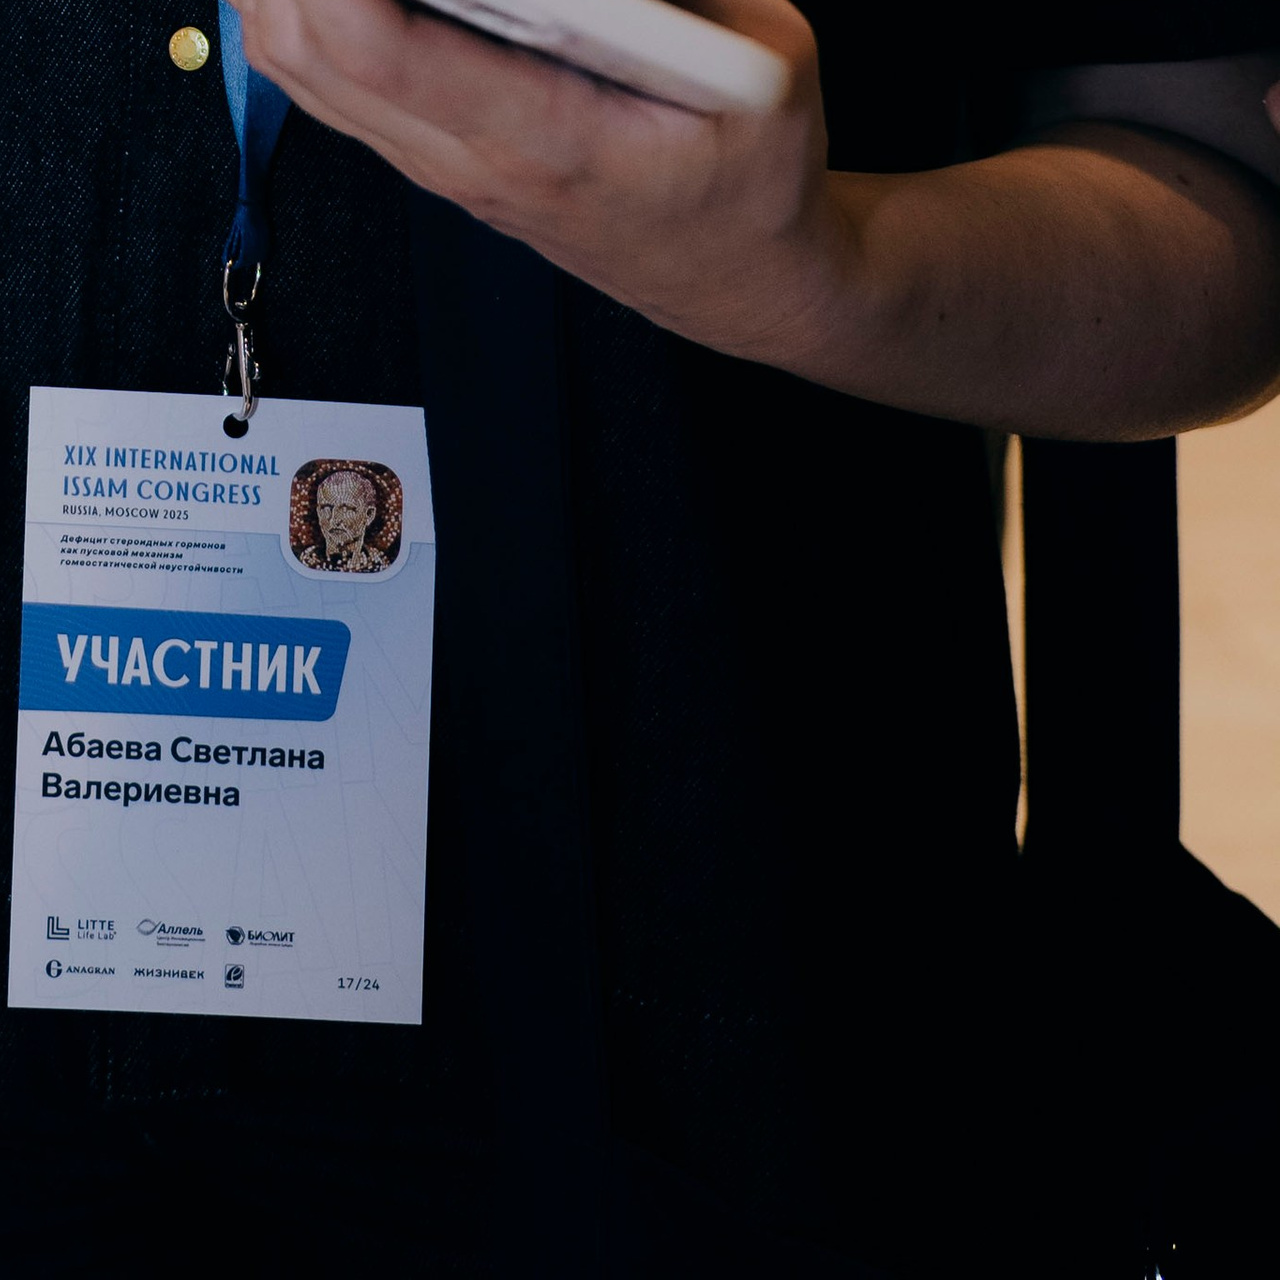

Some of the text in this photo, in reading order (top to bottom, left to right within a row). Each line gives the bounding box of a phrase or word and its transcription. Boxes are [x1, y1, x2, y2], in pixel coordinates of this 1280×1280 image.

[64, 445, 280, 476] XIX INTERNATIONAL
[63, 475, 262, 505] ISSAM CONGRESS
[62, 504, 189, 520] RUSSIA, MOSCOW 2025
[60, 534, 226, 550] Дефицит стероидных гормонов
[80, 547, 129, 558] пусковой
[131, 550, 183, 559] механизм
[60, 558, 244, 575] гомеостатической неустойчивости
[57, 633, 322, 695] УЧАСТНИК
[41, 731, 325, 770] Абаева Светлана
[41, 772, 241, 808] Валериевна
[77, 919, 115, 931] LITTE
[77, 931, 95, 940] Life
[66, 964, 116, 975] ANAGRAN
[337, 977, 380, 991] 17/24
